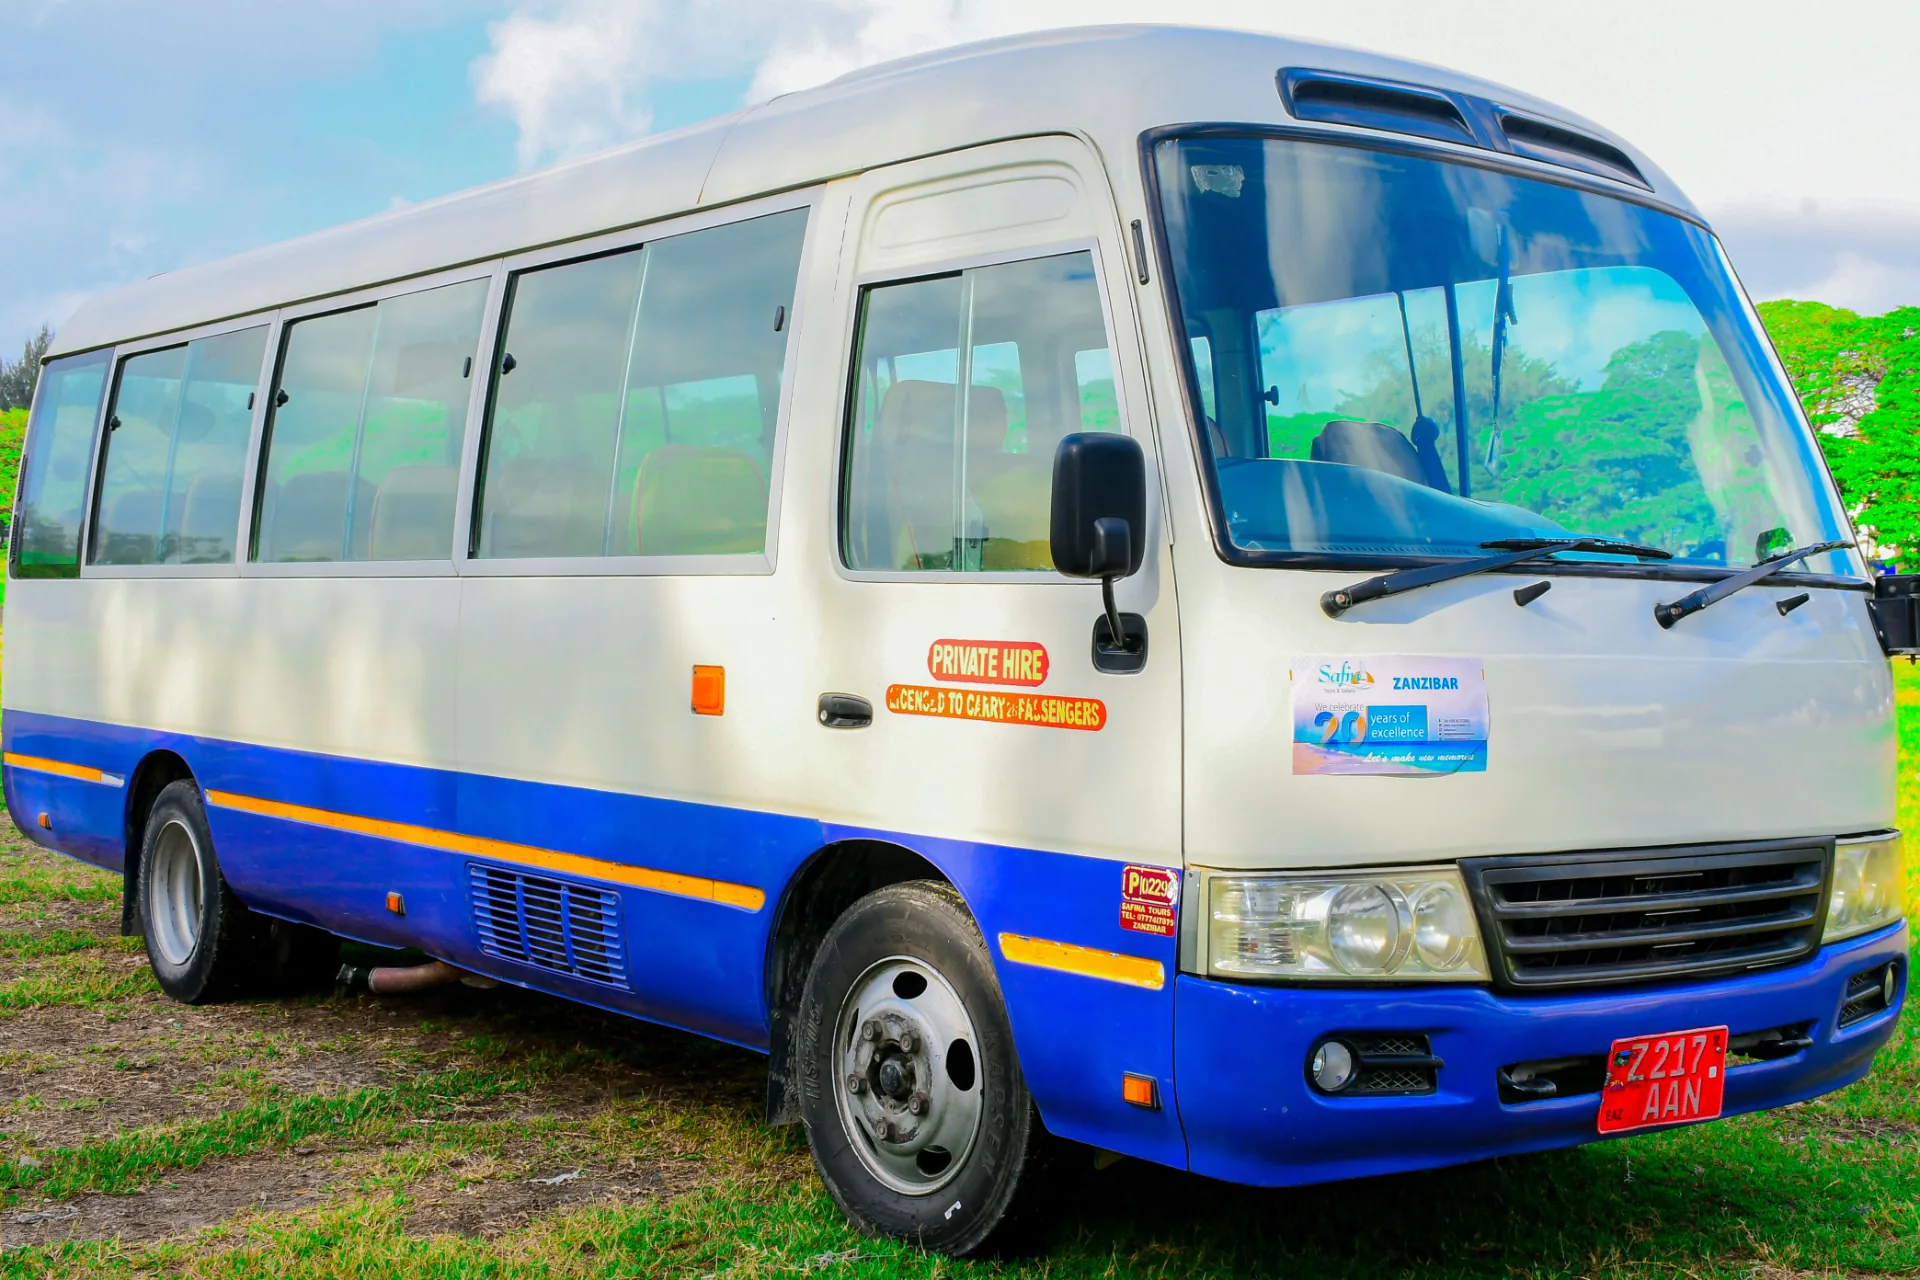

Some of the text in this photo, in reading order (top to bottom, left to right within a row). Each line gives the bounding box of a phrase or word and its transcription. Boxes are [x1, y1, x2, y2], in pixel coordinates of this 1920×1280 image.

[932, 643, 1043, 681] PRIVATE HIRE
[1392, 676, 1459, 690] ZANZIBAR
[948, 691, 964, 715] TO
[1314, 702, 1365, 712] We celebrate
[1370, 711, 1411, 726] years of
[1314, 711, 1367, 746] 20
[1371, 726, 1425, 738] excellence
[1121, 902, 1171, 916] SAFINA TOURS
[1641, 1078, 1702, 1121] AAN
[1605, 1109, 1624, 1122] EAZ
